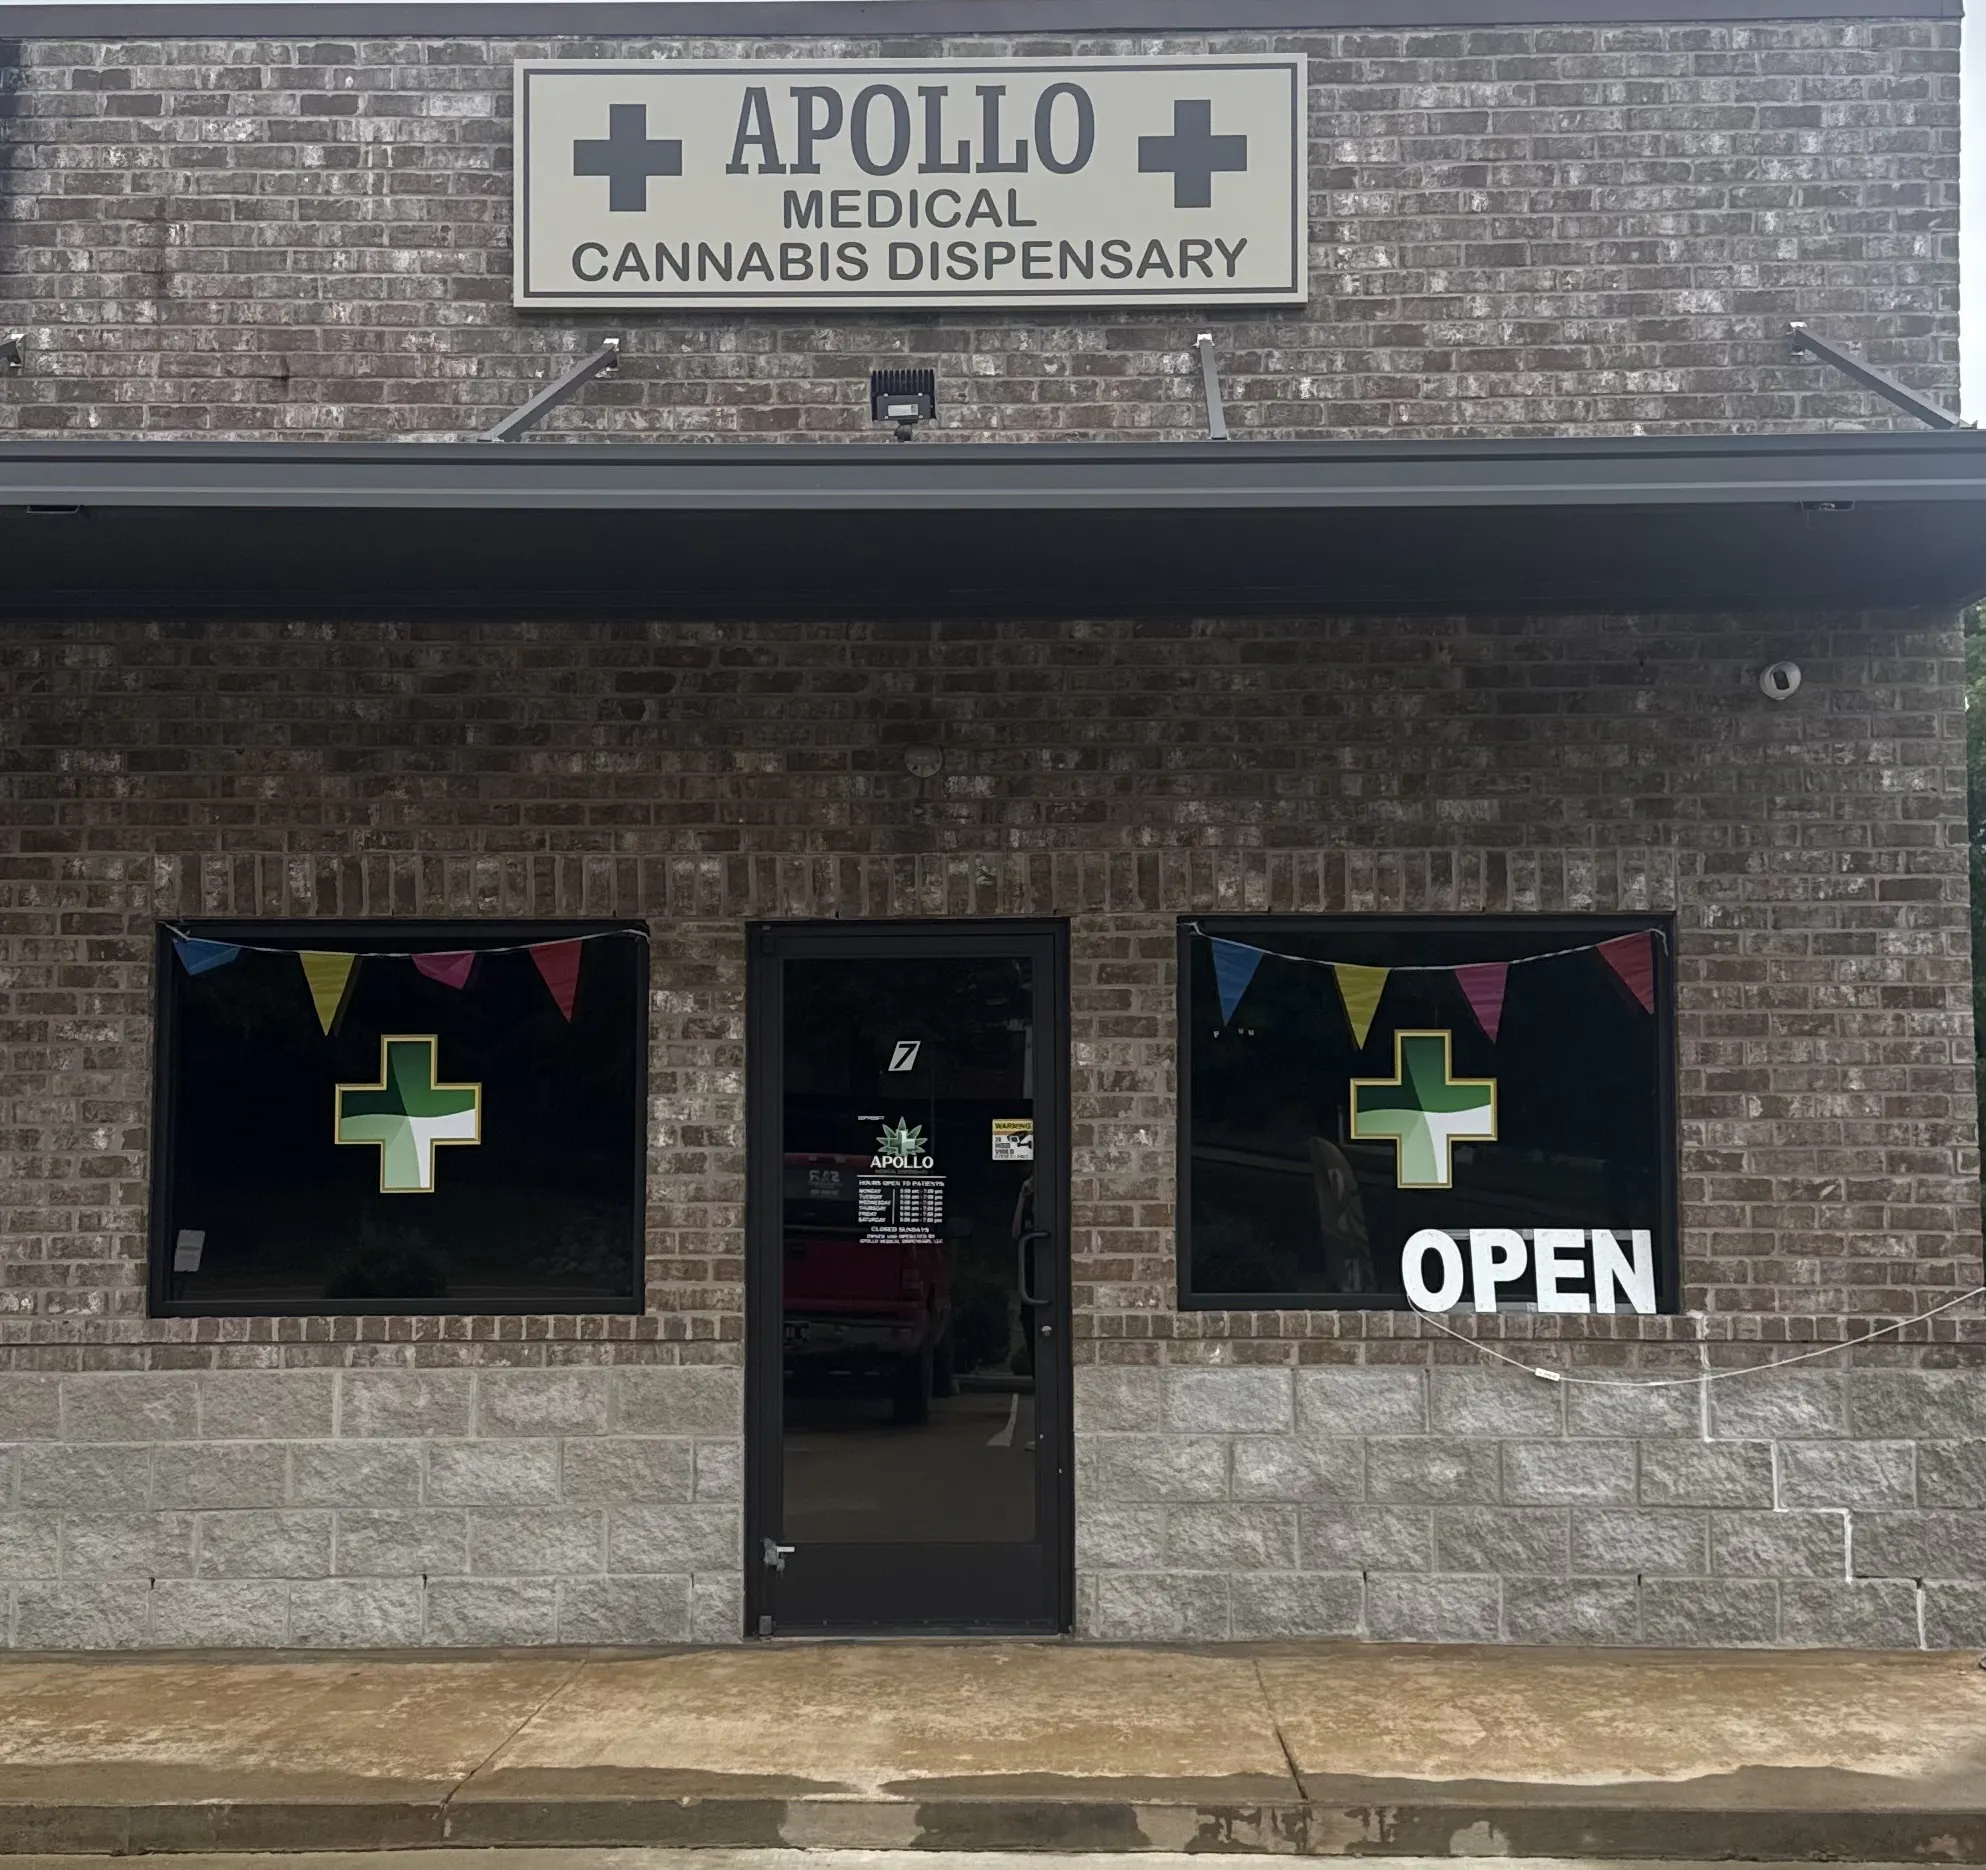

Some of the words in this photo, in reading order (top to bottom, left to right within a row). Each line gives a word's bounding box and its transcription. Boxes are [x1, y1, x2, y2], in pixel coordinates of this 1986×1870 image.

[726, 82, 1094, 176] APOLLO
[783, 188, 1036, 229] MEDICAL
[572, 241, 868, 282] CANNABIS
[889, 237, 1247, 280] DISPENSARY
[891, 1042, 919, 1070] 7
[995, 1122, 1031, 1130] WARNING
[870, 1155, 934, 1169] APOLLO
[1402, 1228, 1657, 1314] OPEN
